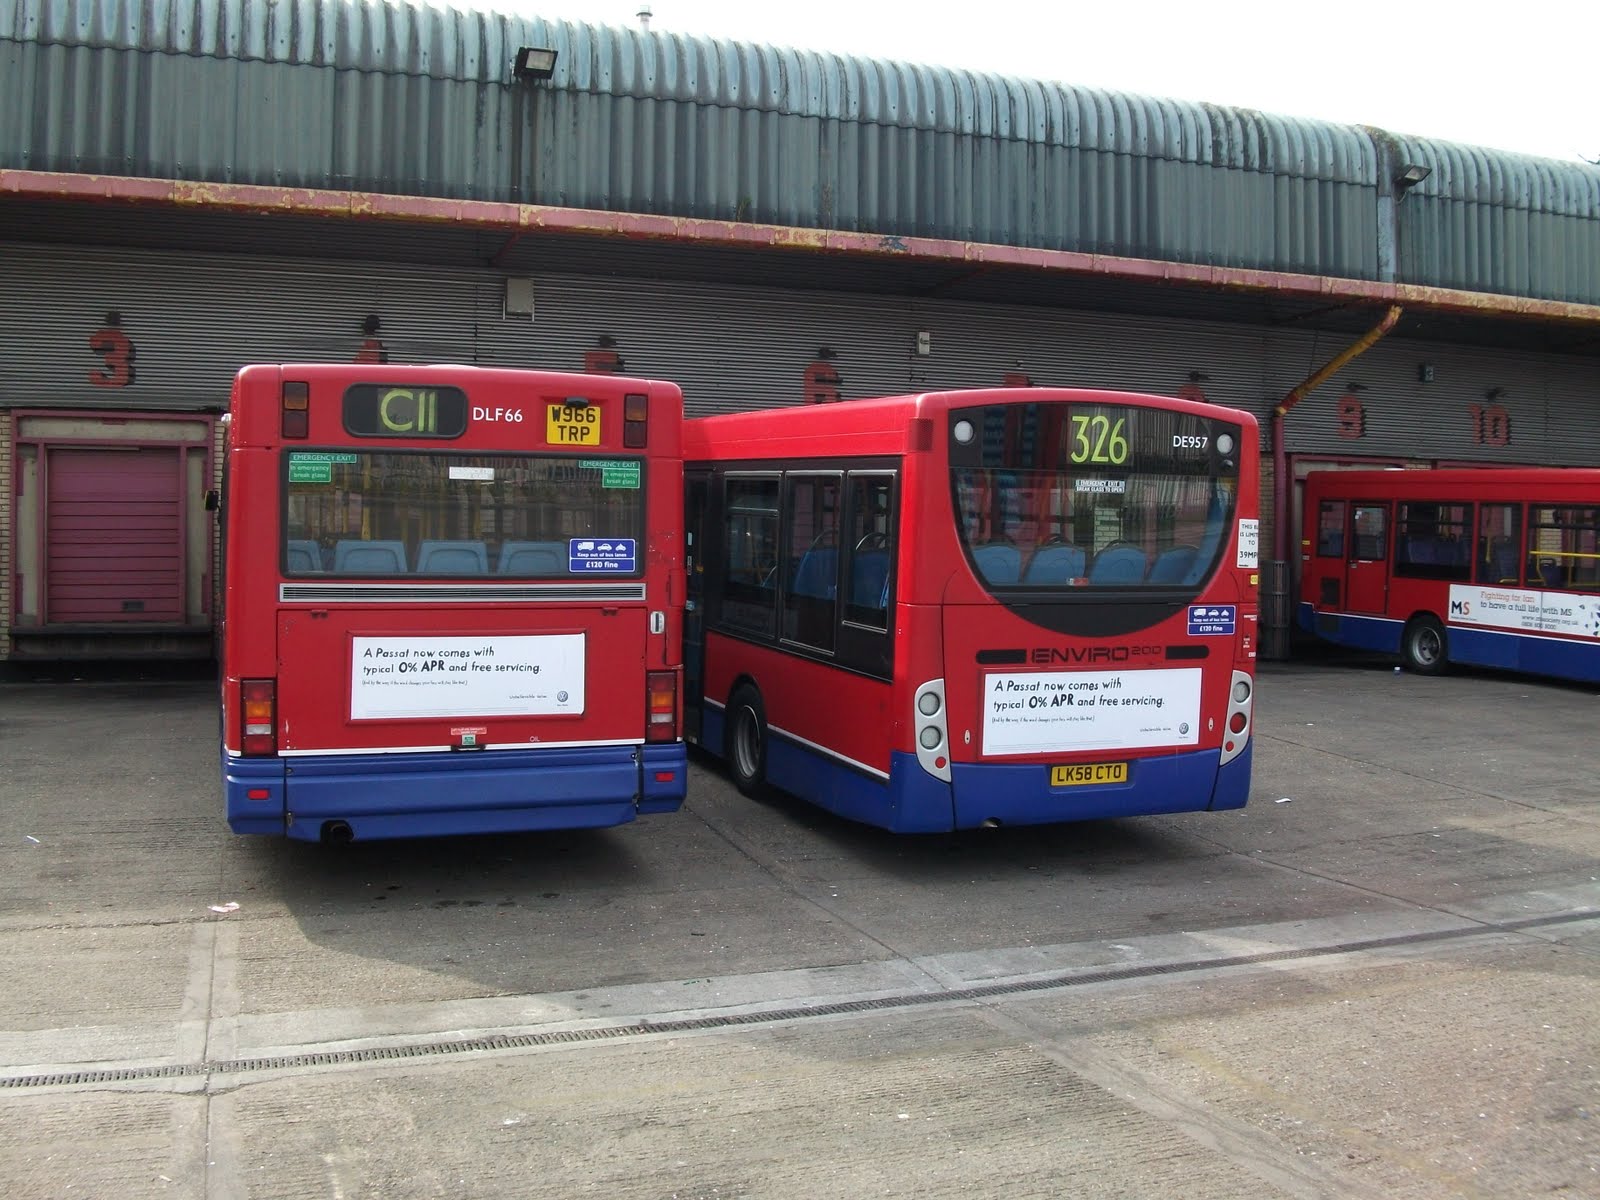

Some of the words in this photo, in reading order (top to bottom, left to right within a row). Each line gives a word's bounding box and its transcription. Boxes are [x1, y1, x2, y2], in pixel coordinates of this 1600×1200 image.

[88, 328, 130, 388] 3
[380, 388, 435, 432] C11
[473, 407, 523, 422] DLF66
[552, 406, 596, 423] W966
[1336, 394, 1363, 441] 9
[1468, 402, 1509, 447] 10
[557, 425, 590, 442] TRP
[1070, 415, 1128, 464] 326
[1173, 435, 1208, 449] DE957
[582, 460, 621, 468] EMERGENCY
[1481, 591, 1510, 602] Fighting
[1451, 600, 1470, 615] MS
[1488, 601, 1506, 610] have
[1528, 605, 1540, 613] life
[1542, 606, 1559, 616] with
[1560, 608, 1572, 617] MS
[364, 647, 372, 658] A
[376, 647, 409, 658] Passat
[413, 650, 435, 658] now
[438, 650, 470, 658] comes
[474, 646, 494, 657] with
[1032, 646, 1128, 663] ENVIRO
[1131, 645, 1161, 655] 200
[363, 663, 394, 676] typical
[398, 662, 418, 673] 0%
[421, 660, 445, 673] APR
[449, 662, 467, 672] and
[471, 661, 492, 672] free
[495, 662, 542, 675] servicing.
[994, 680, 1003, 691] A
[1007, 679, 1040, 691] Passat
[1044, 682, 1066, 691] now
[1068, 682, 1098, 691] comes
[1102, 677, 1122, 689] with
[993, 699, 1024, 712] typical
[1029, 696, 1048, 708] 0%
[1050, 693, 1074, 707] APR
[1077, 695, 1095, 706] and
[1099, 694, 1119, 706] free
[1121, 694, 1165, 708] servicing.
[1057, 766, 1092, 782] LK58
[1096, 764, 1121, 780] CTO
